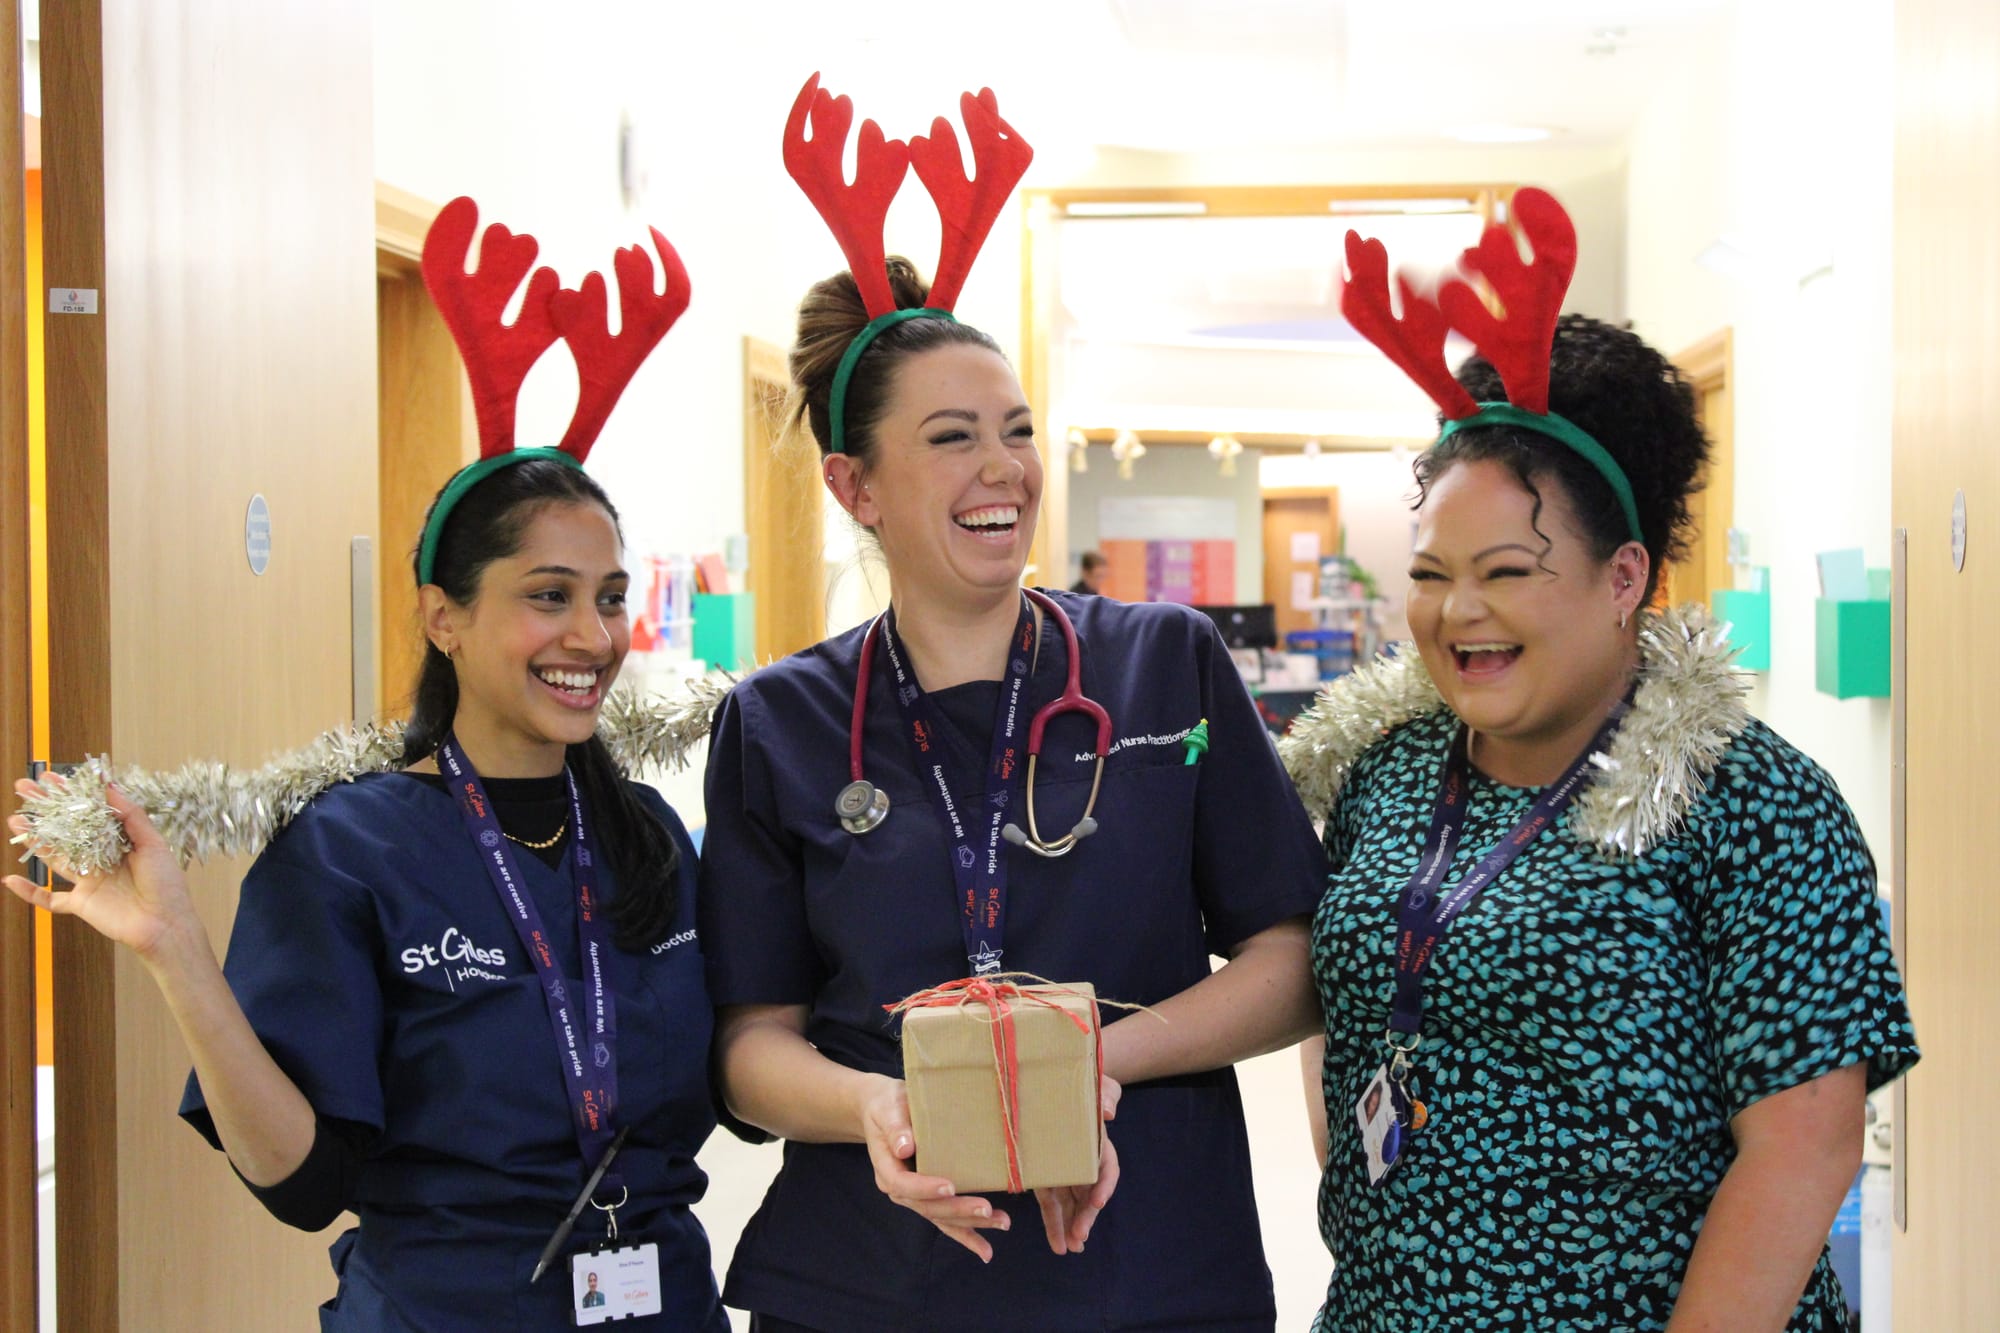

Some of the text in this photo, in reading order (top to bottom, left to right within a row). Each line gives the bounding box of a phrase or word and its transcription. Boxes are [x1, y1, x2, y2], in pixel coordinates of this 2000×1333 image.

[896, 668, 905, 683] We
[1005, 678, 1022, 738] We are creative
[919, 741, 929, 752] St
[1006, 748, 1014, 758] St
[1120, 736, 1148, 748] Nurse
[1148, 728, 1191, 745] Practitioner
[448, 757, 462, 776] care
[464, 782, 475, 794] St
[933, 764, 965, 839] We are trustworthy
[1548, 776, 1580, 807] creative
[988, 812, 1002, 875] We take pride
[493, 850, 528, 920] We are creative
[1472, 873, 1488, 885] We
[988, 888, 1000, 928] St Giles
[1436, 901, 1456, 924] pride
[400, 943, 440, 974] St
[440, 926, 506, 966] Giles
[532, 930, 542, 942] St
[537, 942, 552, 969] Giles
[589, 940, 604, 1034] We are trustworthy
[559, 1008, 582, 1078] We take pride
[583, 1090, 600, 1132] St Giles
